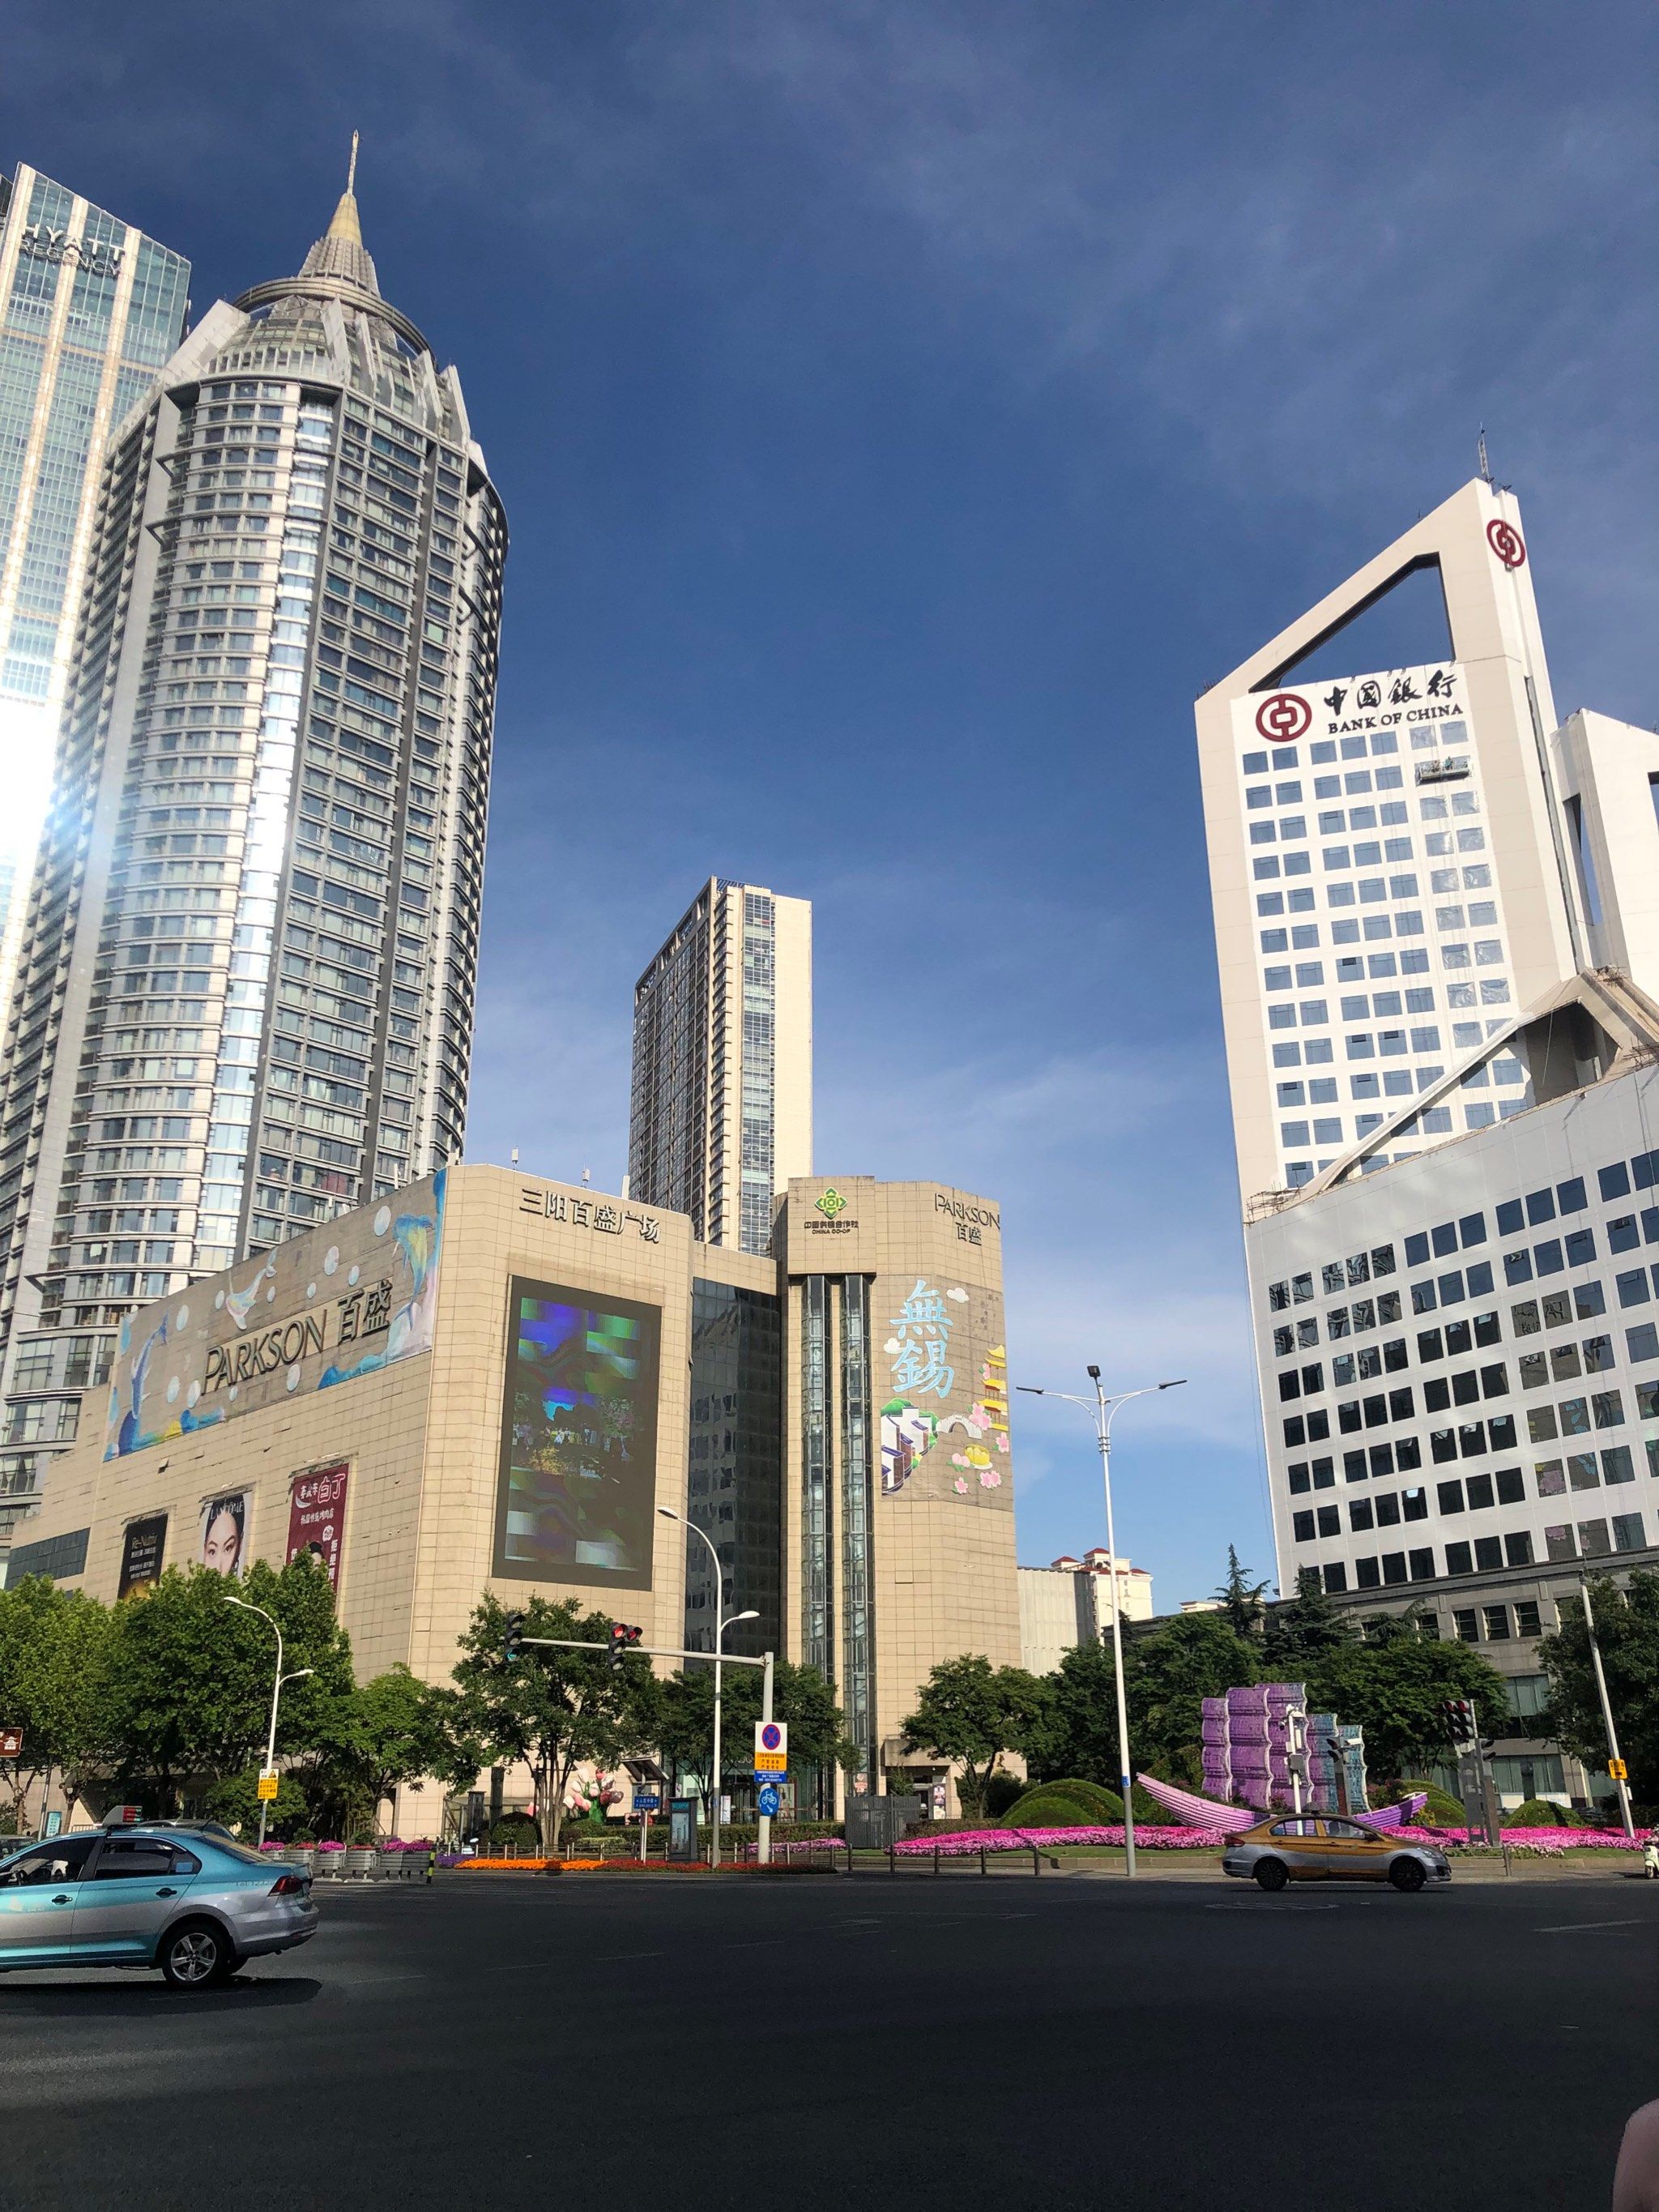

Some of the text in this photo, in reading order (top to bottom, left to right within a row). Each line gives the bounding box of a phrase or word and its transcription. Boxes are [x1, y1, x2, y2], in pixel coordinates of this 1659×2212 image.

[20, 239, 122, 275] REGNCY
[22, 223, 125, 261] HYATT
[1328, 703, 1463, 734] BANK OF CHINA
[519, 1188, 662, 1245] 三阳百盛广场
[935, 1193, 1000, 1230] PARKSON
[955, 1222, 982, 1246] 百盛
[201, 1279, 394, 1395] PARKSON 百盛
[889, 1279, 955, 1399] 無錫
